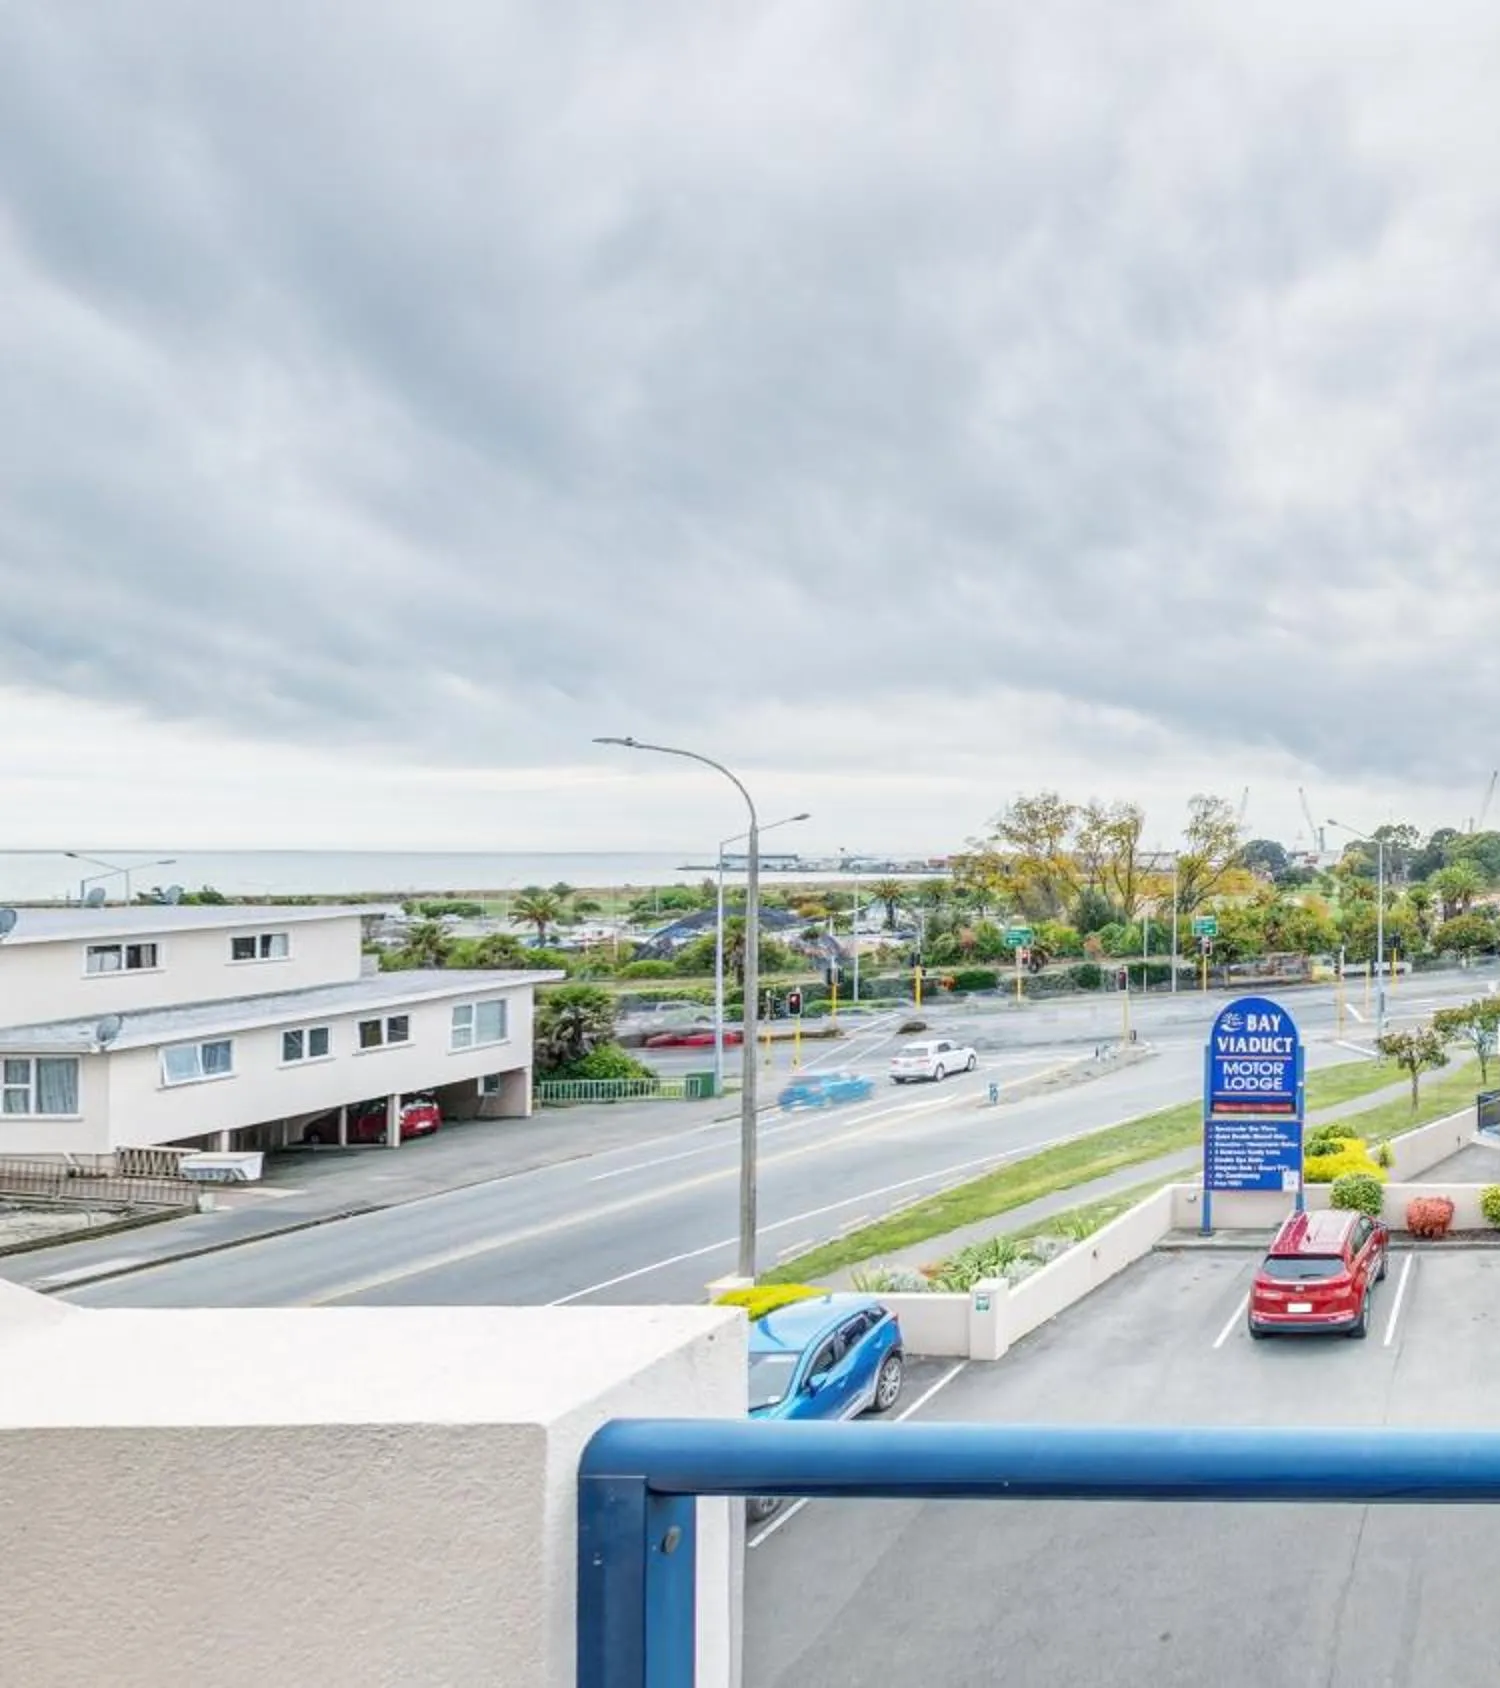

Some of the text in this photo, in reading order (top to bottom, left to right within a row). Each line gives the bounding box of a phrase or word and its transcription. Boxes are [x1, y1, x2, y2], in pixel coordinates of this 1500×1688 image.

[1246, 1013, 1281, 1032] BAY
[1217, 1036, 1293, 1053] VIADUCT
[1223, 1061, 1284, 1075] MOTOR
[1224, 1077, 1283, 1090] LODGE
